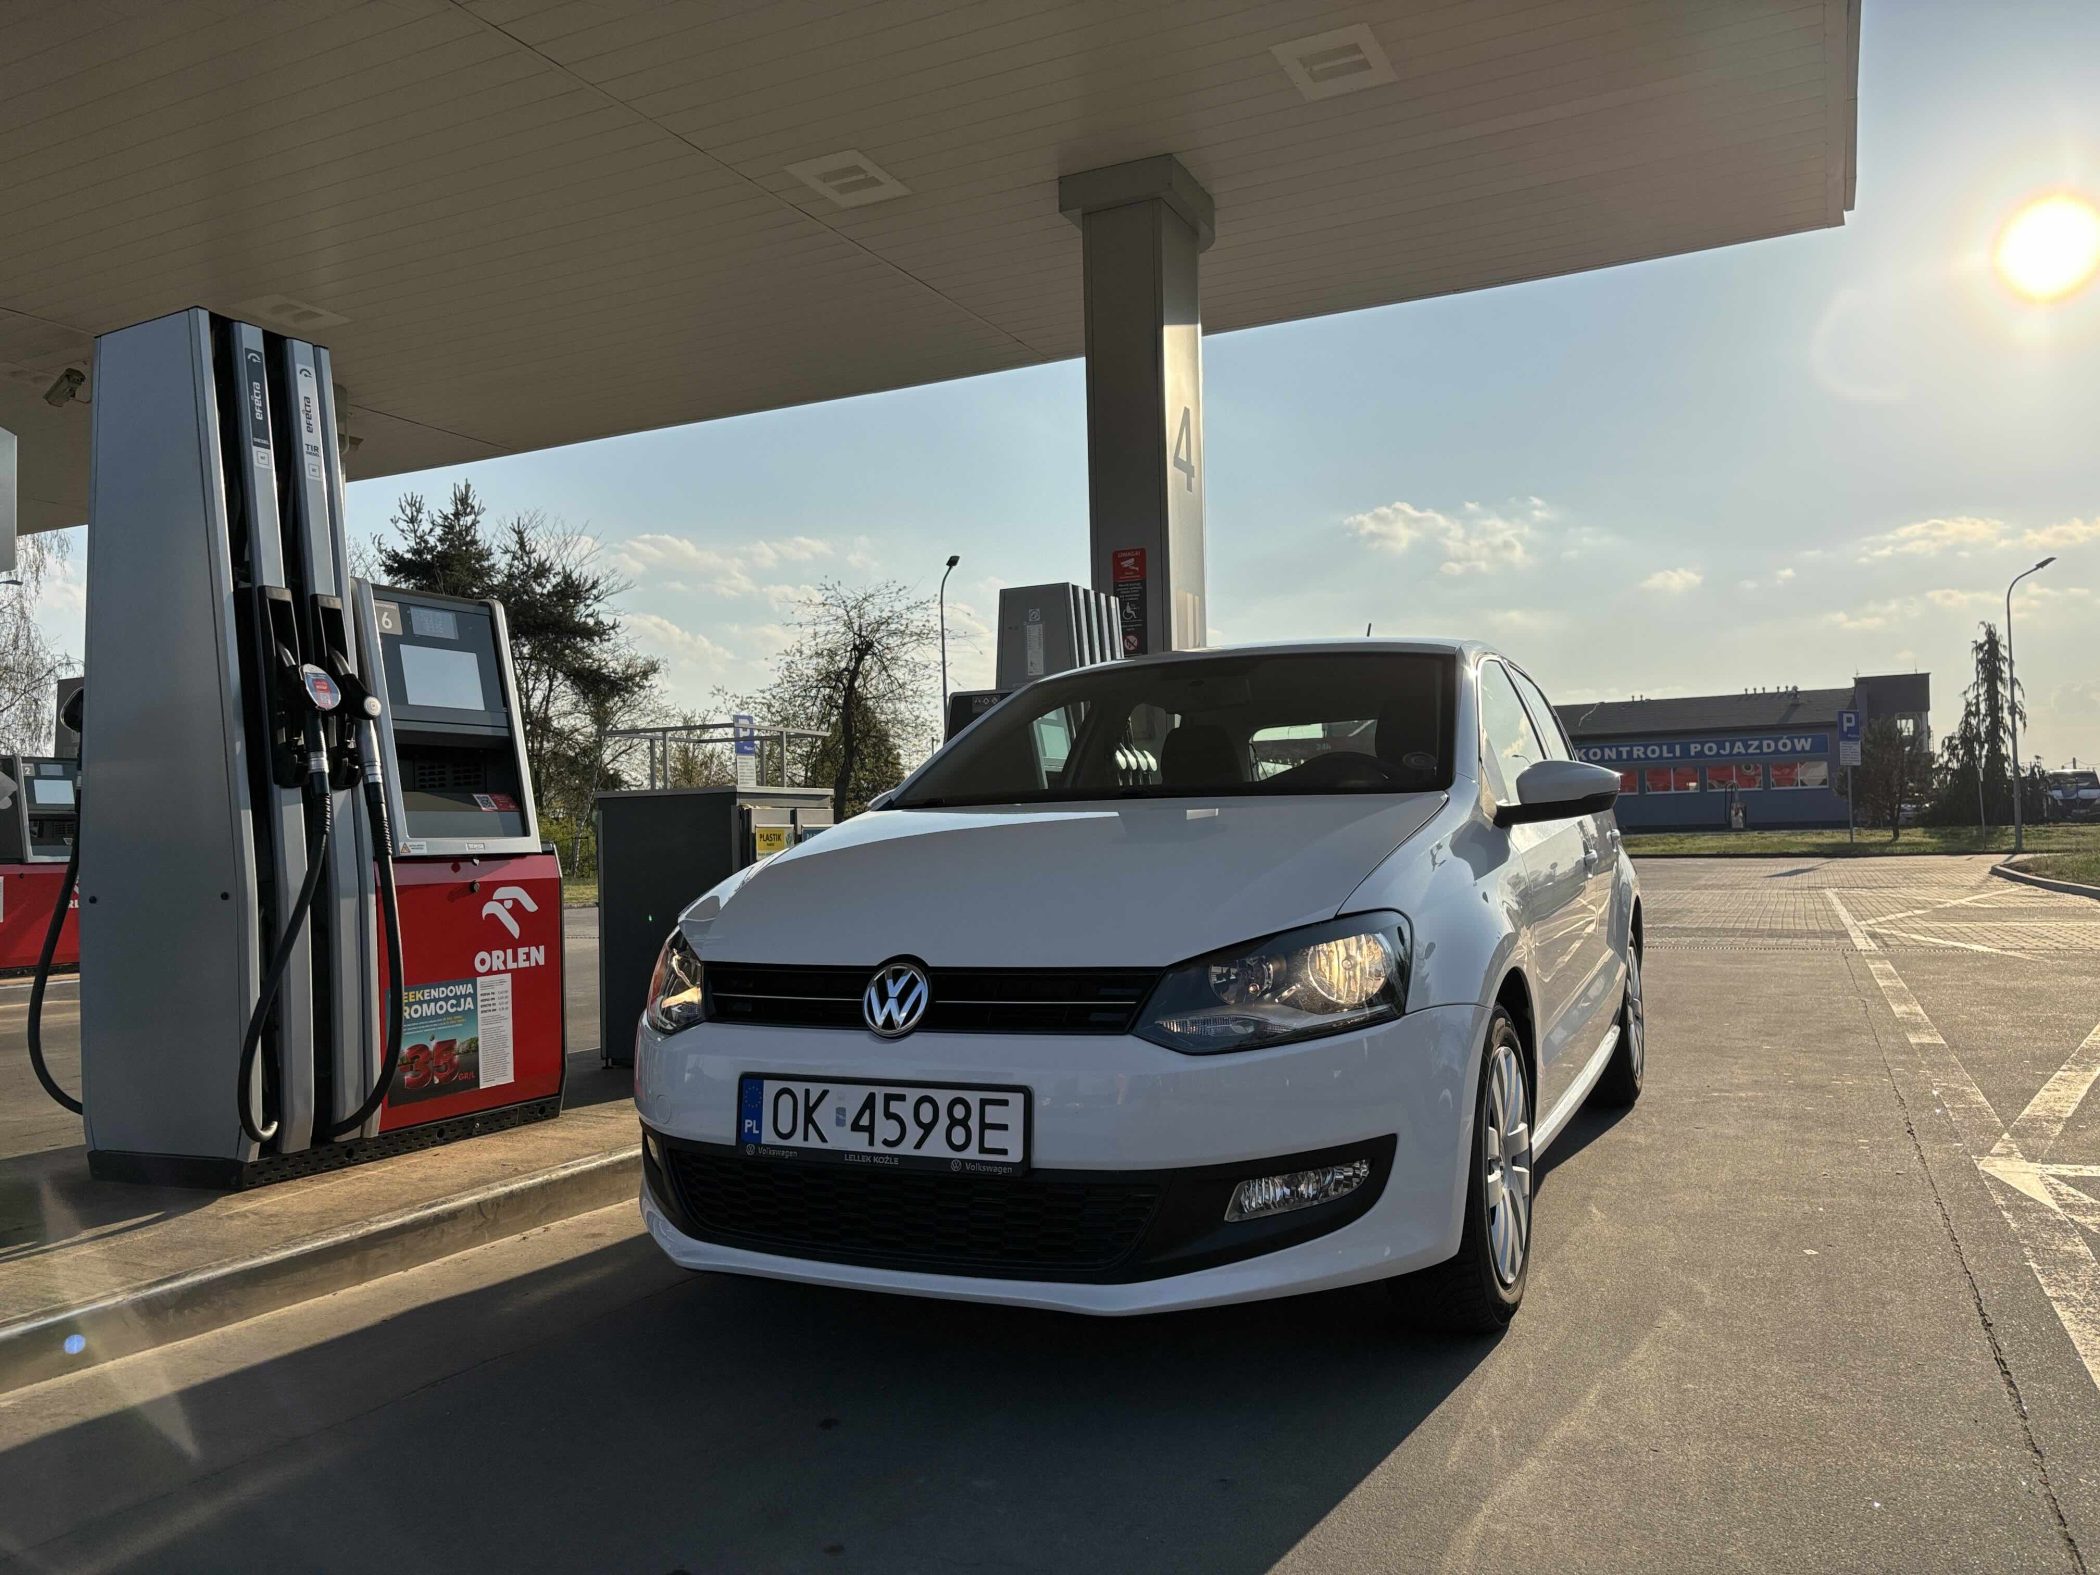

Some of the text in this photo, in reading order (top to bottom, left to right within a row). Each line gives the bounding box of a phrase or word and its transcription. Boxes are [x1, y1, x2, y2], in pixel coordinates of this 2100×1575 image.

[304, 443, 320, 453] TIR
[1173, 405, 1195, 493] 4
[381, 611, 393, 630] 6
[1842, 712, 1856, 732] P
[1575, 736, 1813, 761] KONTROLI POJAZDÓW
[24, 766, 31, 776] 2
[759, 832, 782, 842] PLASTIK
[474, 944, 545, 973] ORLEN
[402, 983, 474, 1004] EEKENDOWA
[402, 996, 474, 1020] ROMOCJA
[744, 1118, 760, 1135] PL
[772, 1086, 1010, 1156] OK 4598E
[758, 1145, 798, 1158] Volkswagen
[844, 1153, 872, 1164] LELLEK
[965, 1160, 1013, 1174] Volkswagen
